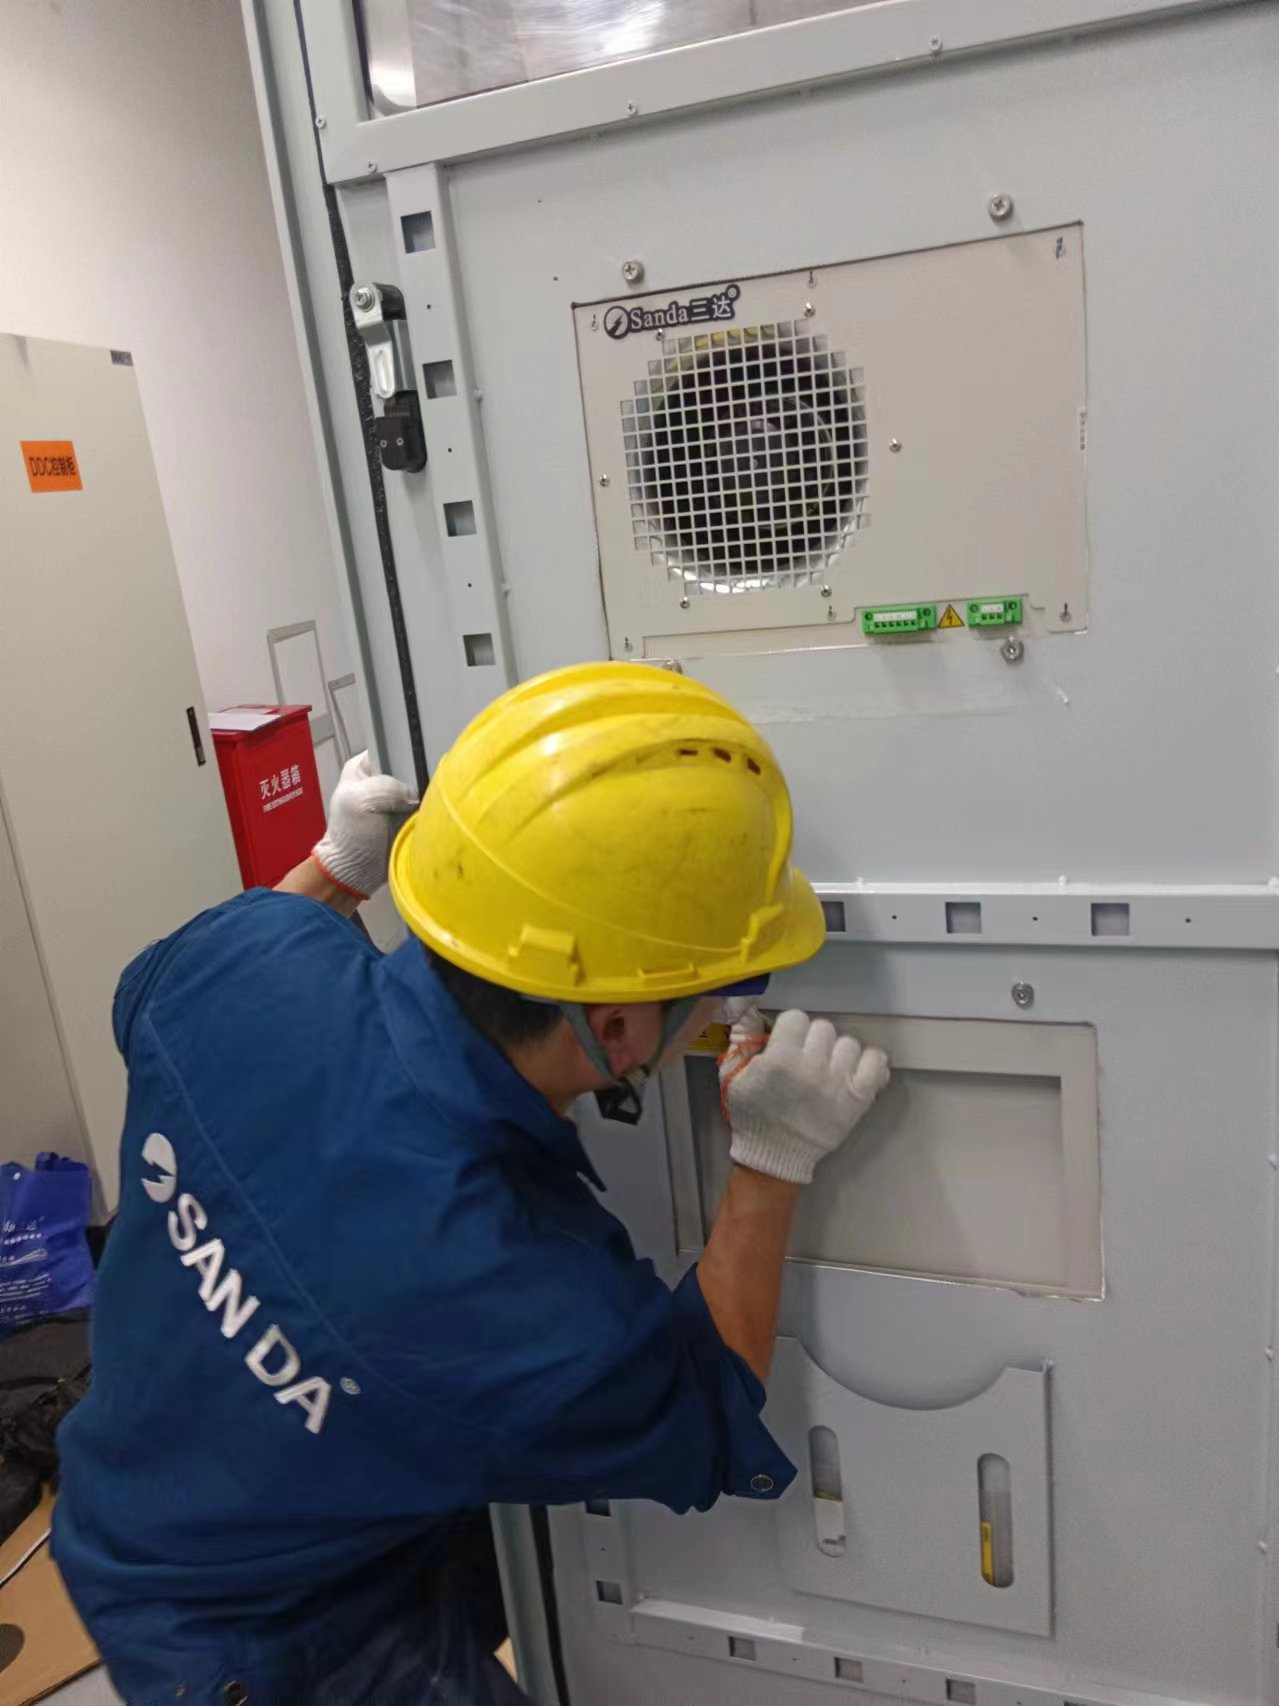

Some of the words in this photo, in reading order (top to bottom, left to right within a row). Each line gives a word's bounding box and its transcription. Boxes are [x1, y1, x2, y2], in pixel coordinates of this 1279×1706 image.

[259, 764, 301, 800] 灭火器箱
[168, 1192, 332, 1435] SANDA
